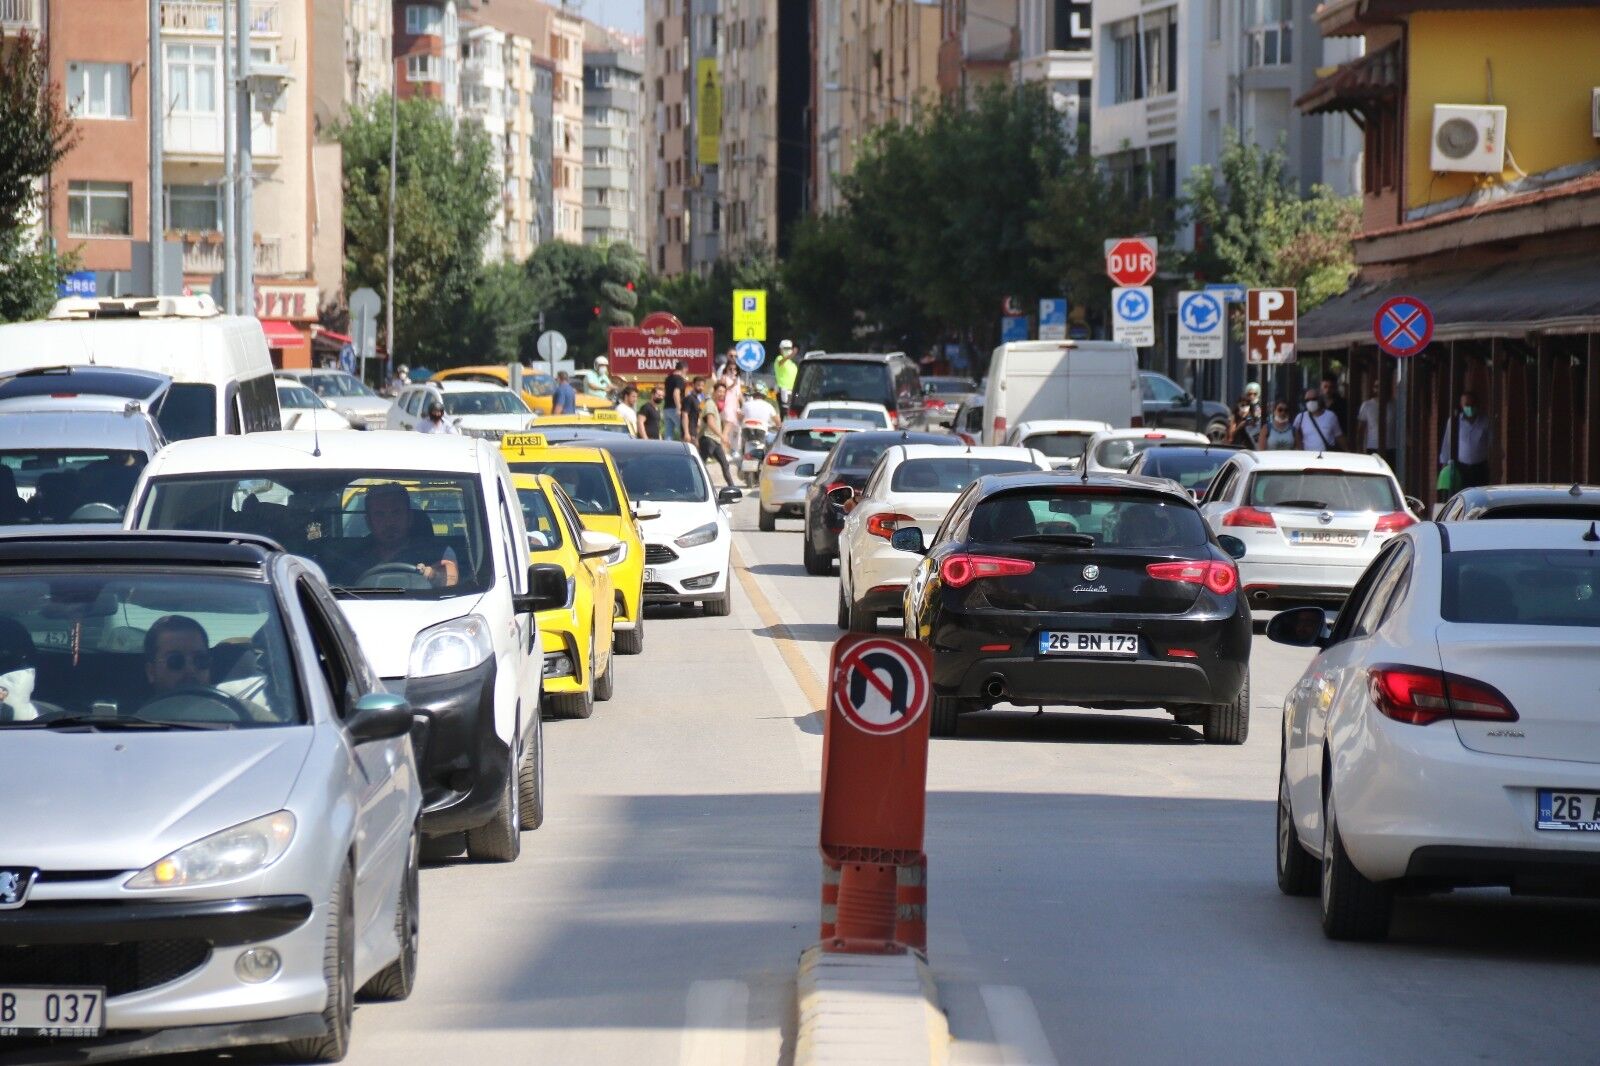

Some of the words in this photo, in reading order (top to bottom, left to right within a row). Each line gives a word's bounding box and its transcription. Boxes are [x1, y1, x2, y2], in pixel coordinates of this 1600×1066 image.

[1110, 253, 1153, 273] DUR
[744, 298, 755, 311] P
[1040, 299, 1055, 321] P
[1258, 291, 1285, 321] P
[614, 347, 646, 358] YILMAZ
[1049, 633, 1069, 650] 26
[1077, 634, 1102, 650] BN
[1107, 635, 1137, 652] 173
[1541, 809, 1552, 817] TR
[1553, 795, 1581, 820] 26
[1, 992, 16, 1022] B
[46, 993, 97, 1024] 037
